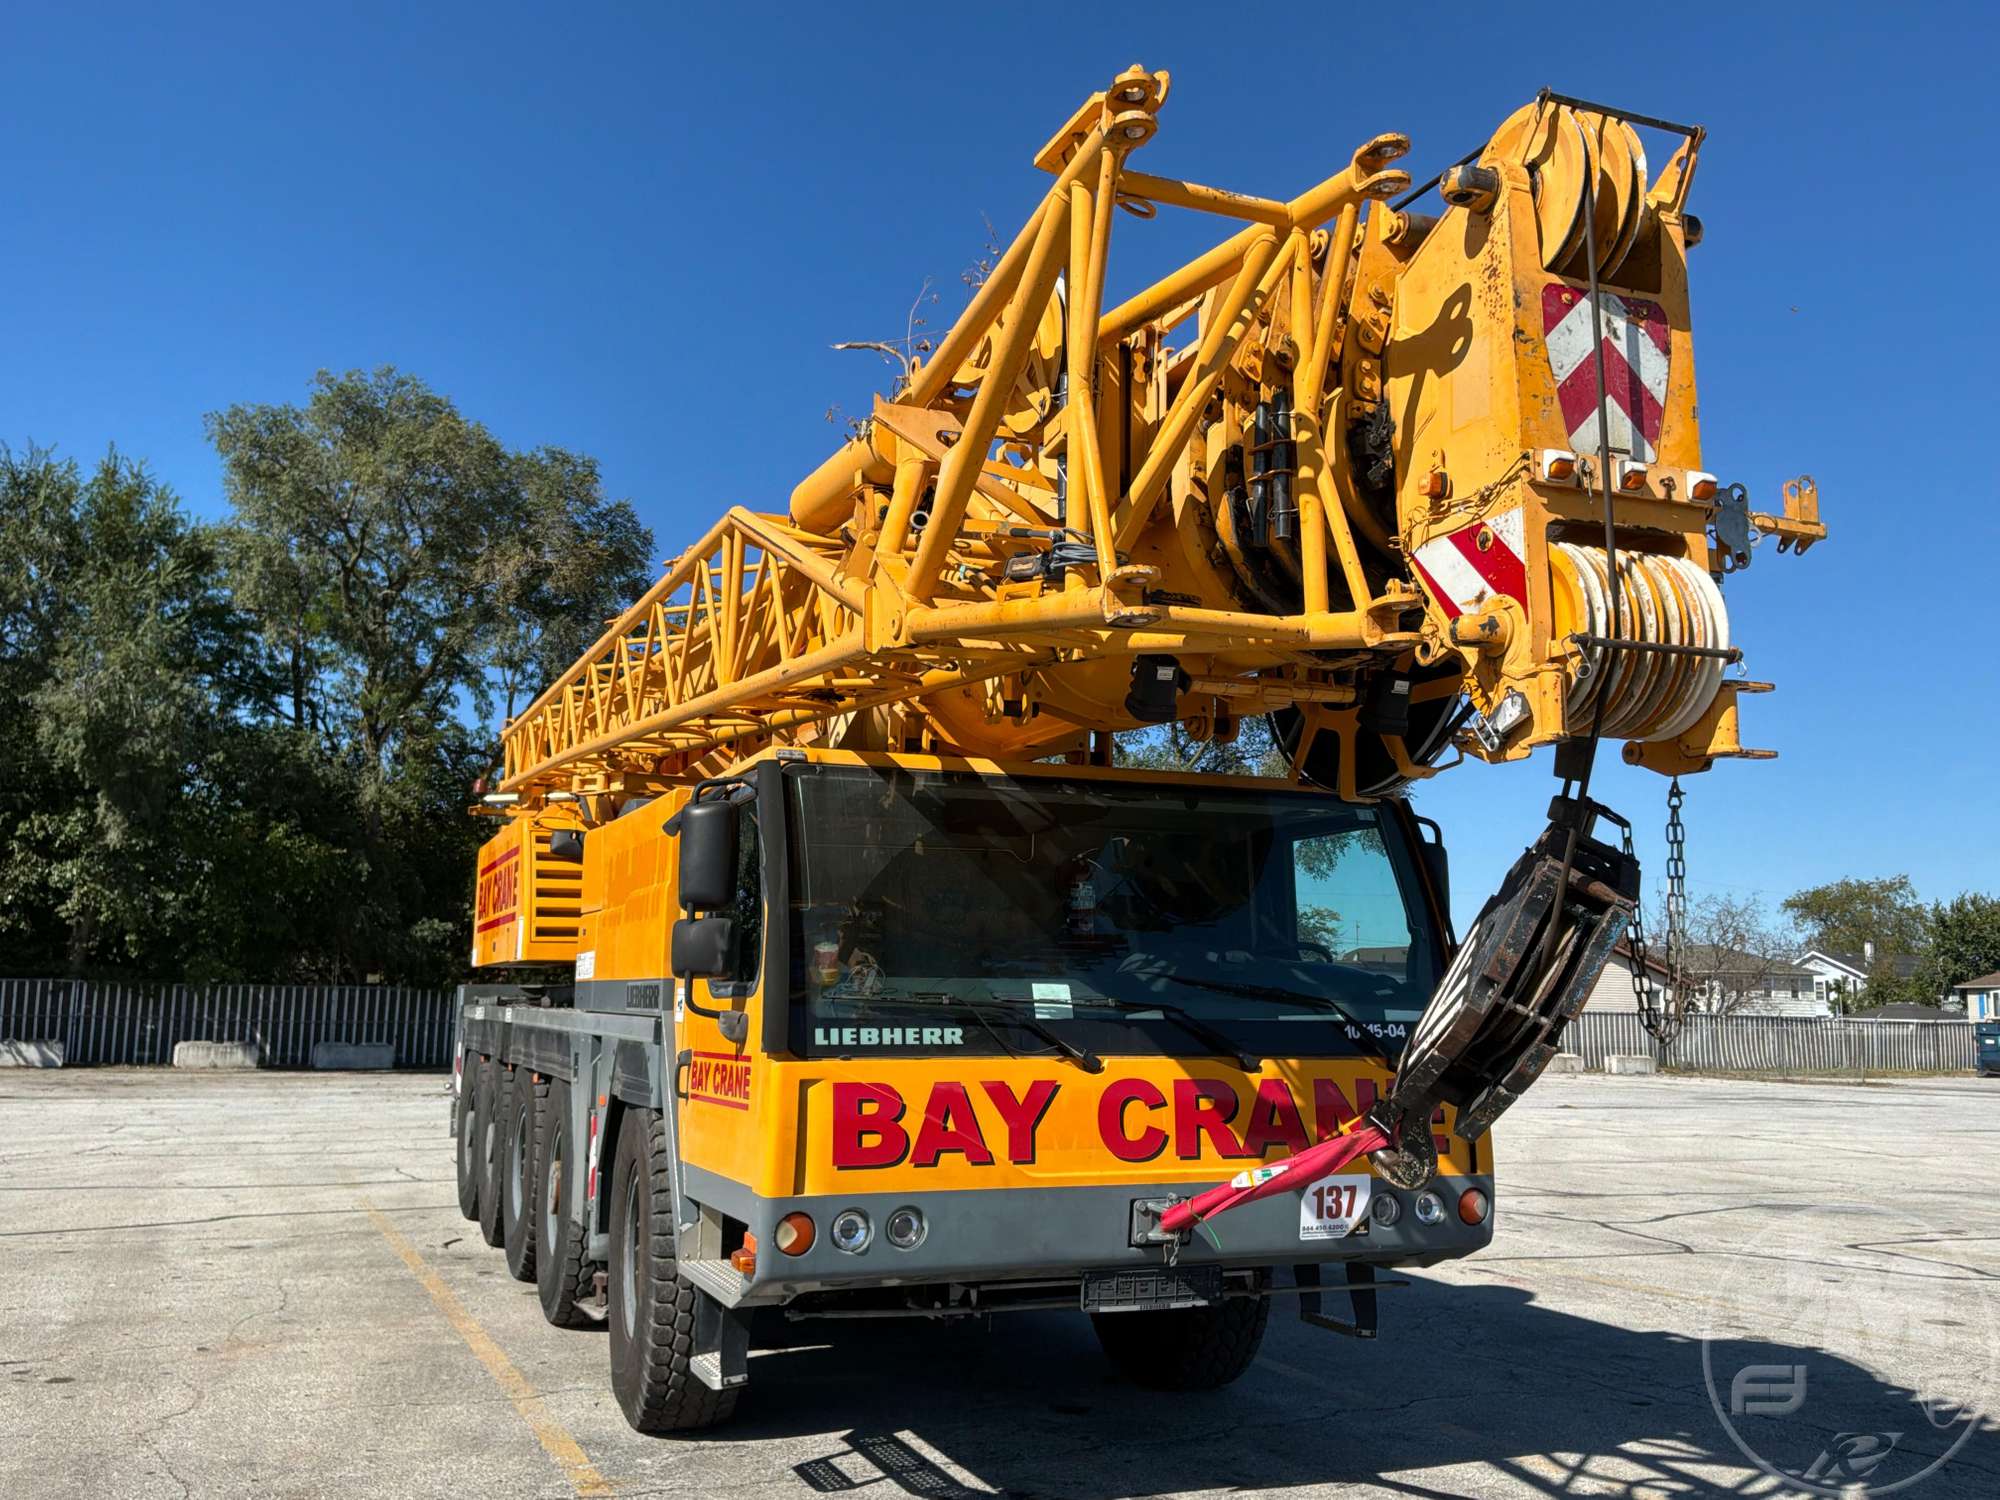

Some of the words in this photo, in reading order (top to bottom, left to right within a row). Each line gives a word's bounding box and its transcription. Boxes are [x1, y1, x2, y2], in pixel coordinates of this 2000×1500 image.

[478, 875, 493, 921] BAY
[493, 861, 519, 914] CRANE
[814, 1027, 965, 1046] LIEBHERR
[1344, 1024, 1406, 1039] 1015-04
[691, 1060, 711, 1092] BAY
[713, 1062, 752, 1100] CRANE
[832, 1080, 1060, 1170] BAY
[1098, 1078, 1450, 1162] CRAN
[1311, 1184, 1357, 1220] 137
